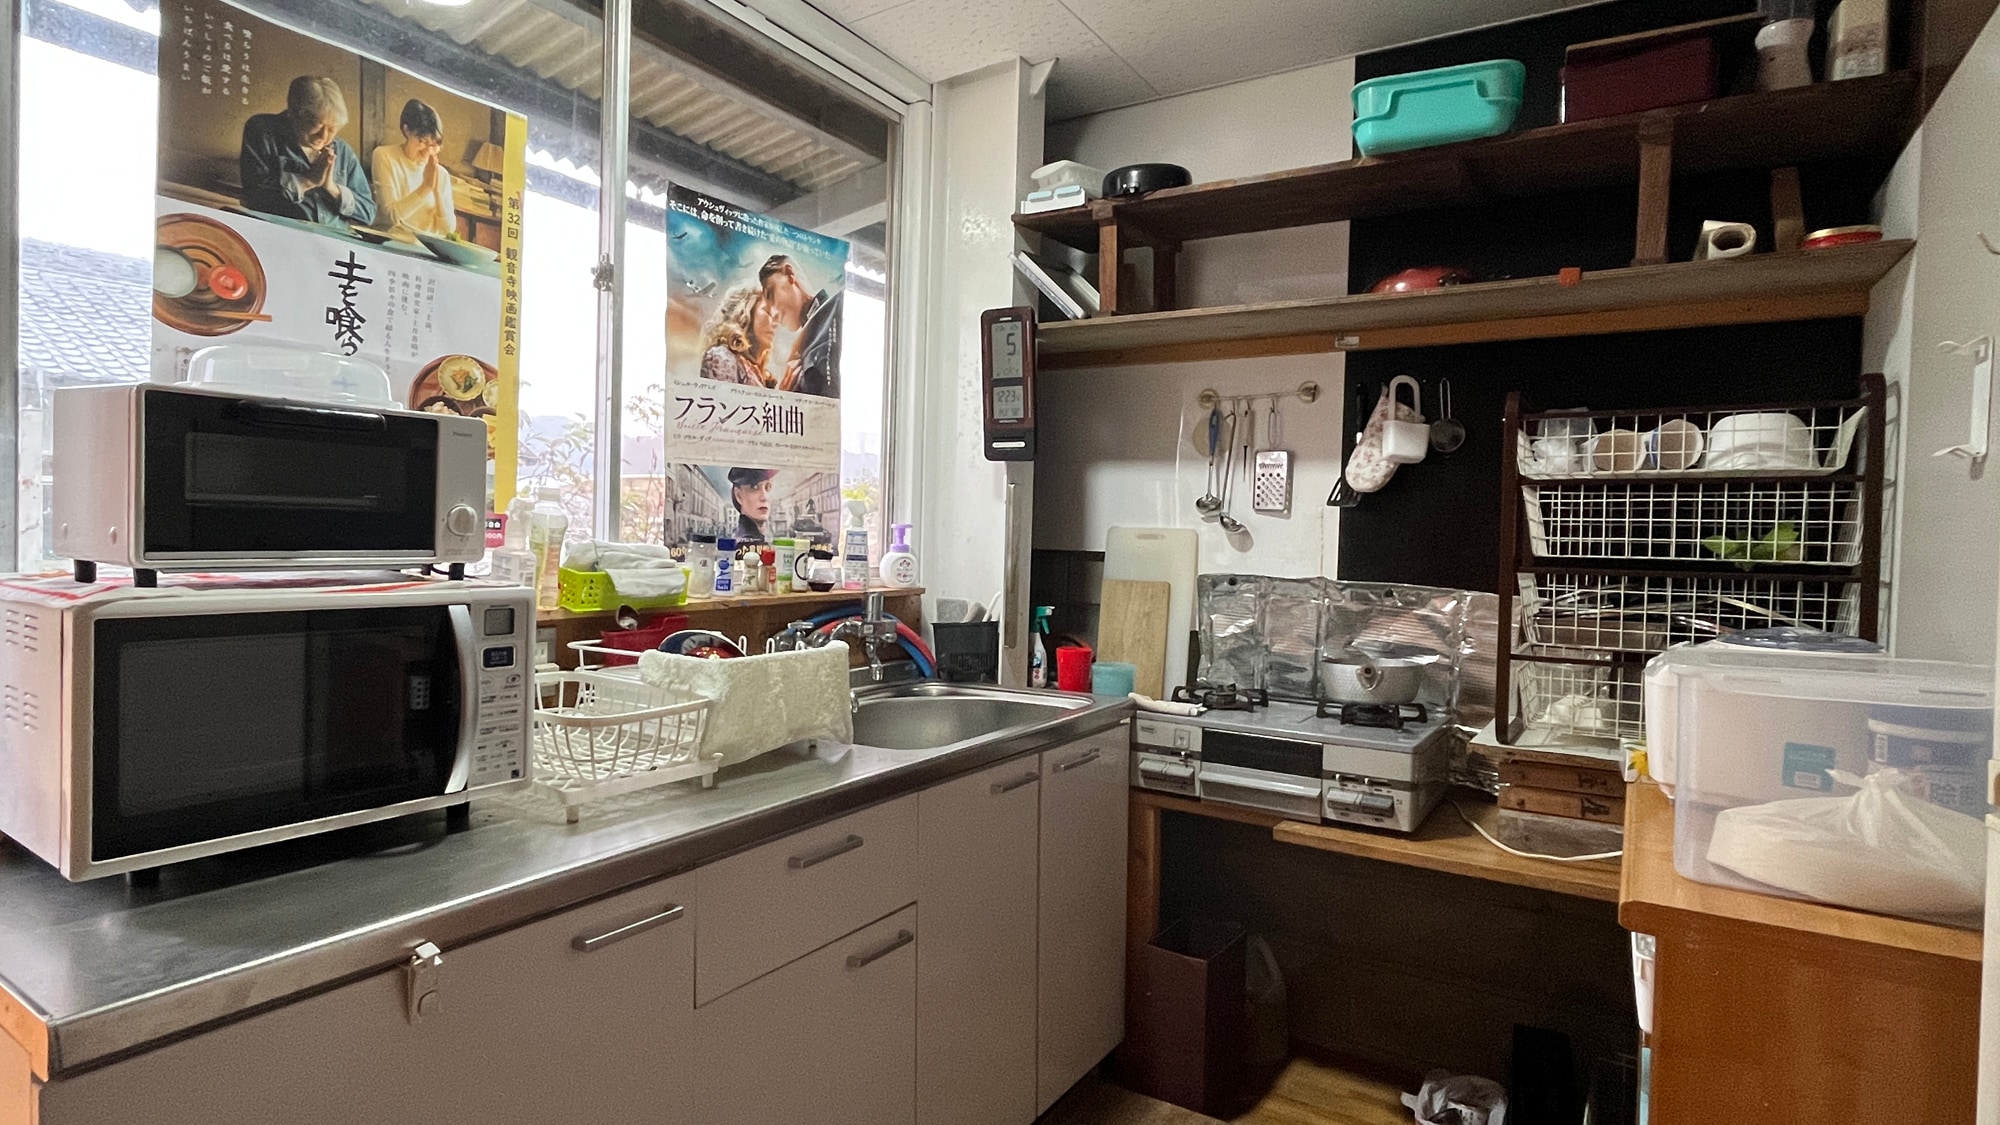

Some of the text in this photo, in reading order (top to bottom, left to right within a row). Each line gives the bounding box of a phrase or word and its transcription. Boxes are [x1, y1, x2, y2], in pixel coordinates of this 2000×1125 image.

[1006, 333, 1017, 356] 5
[673, 396, 804, 437] フランス組曲
